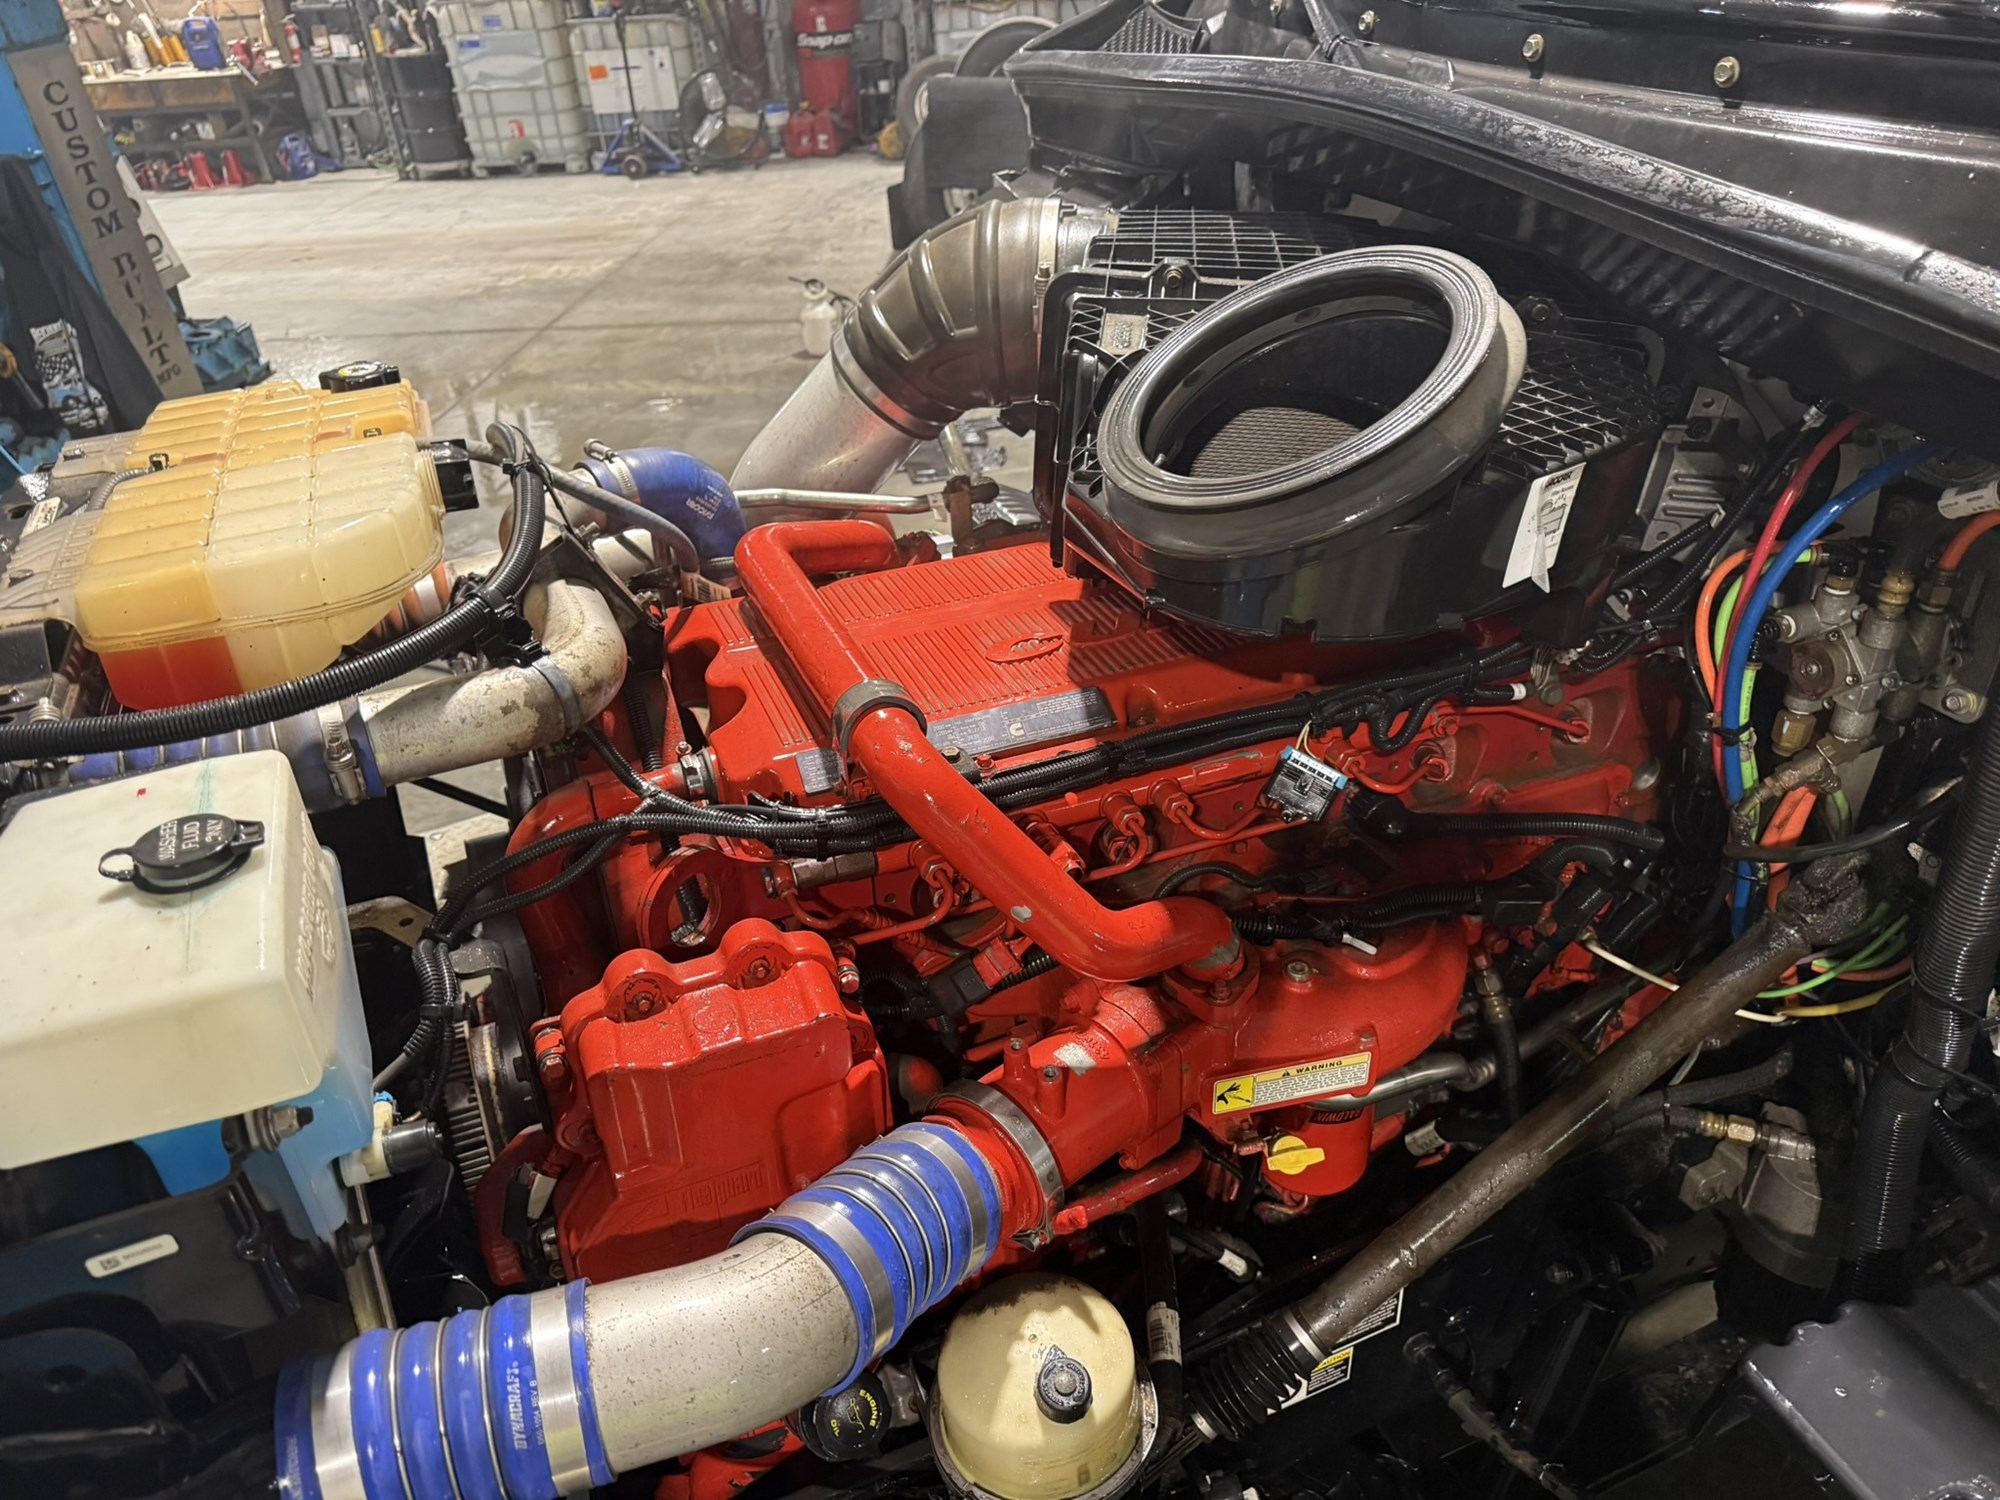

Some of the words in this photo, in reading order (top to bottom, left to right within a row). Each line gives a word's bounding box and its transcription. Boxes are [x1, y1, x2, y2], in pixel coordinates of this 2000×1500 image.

[43, 80, 124, 238] CUSTOM
[112, 252, 169, 367] BUILT
[158, 820, 178, 860] WASHER
[181, 820, 200, 850] FLUID
[1295, 1060, 1343, 1075] WARNING
[859, 1388, 878, 1427] ENGINE
[830, 1419, 841, 1437] OIL
